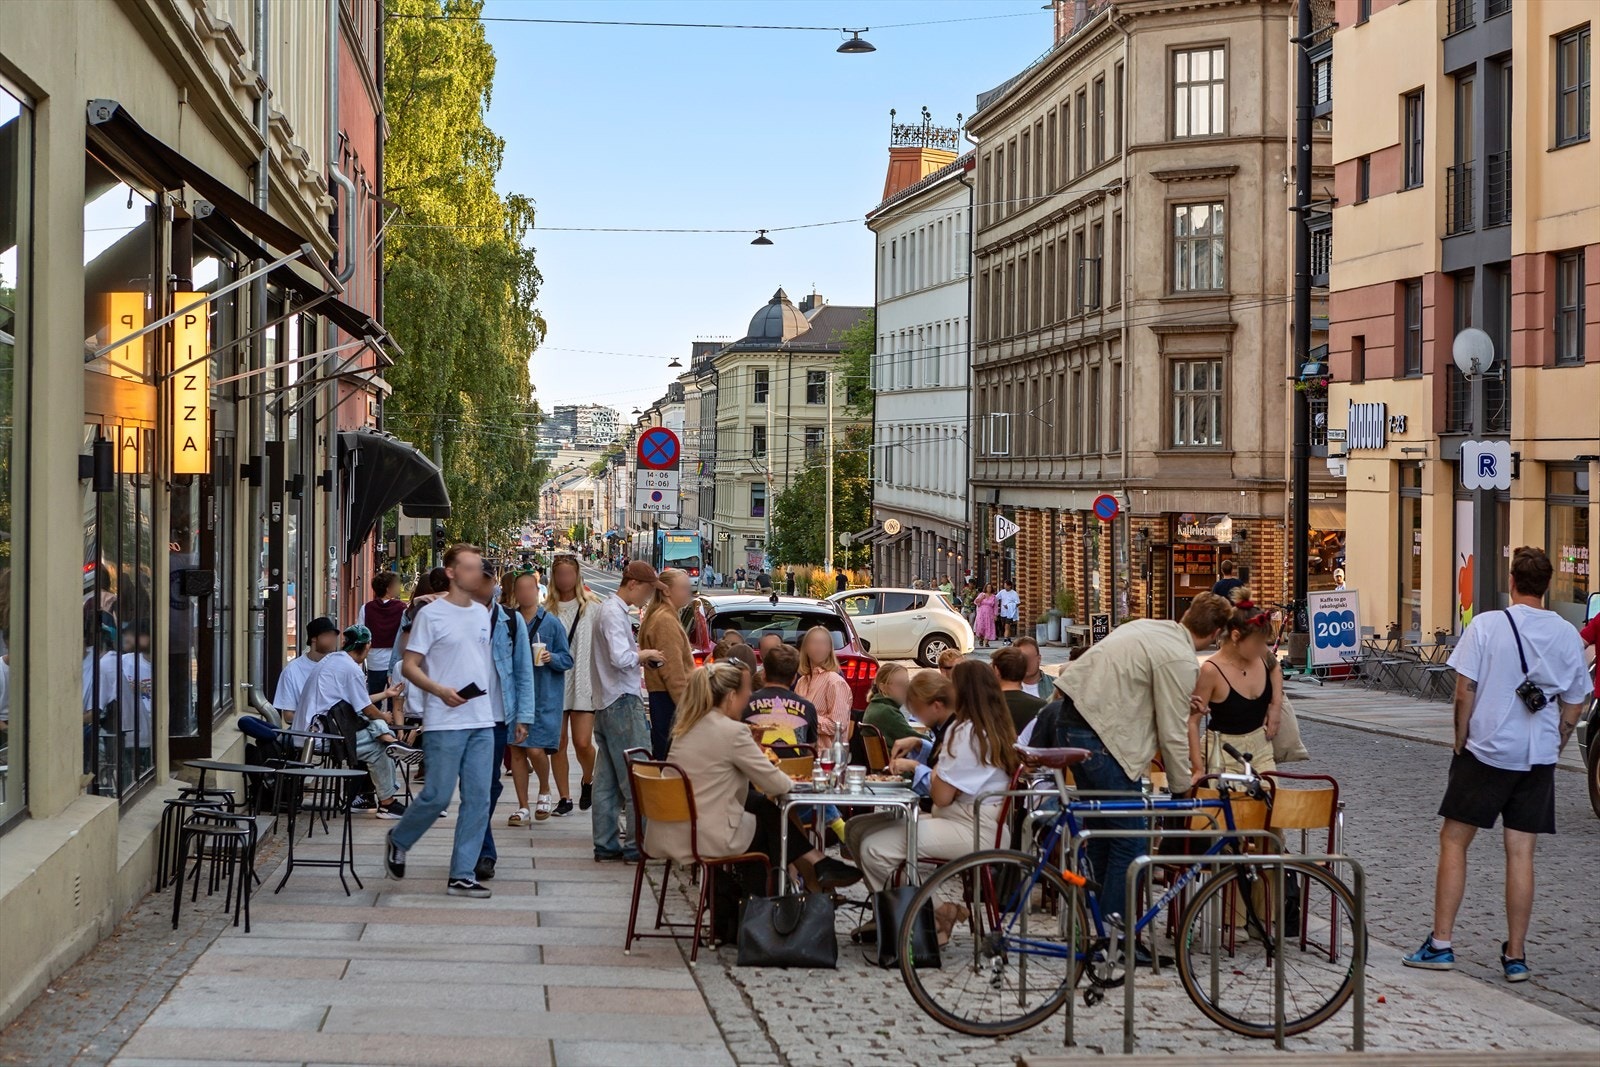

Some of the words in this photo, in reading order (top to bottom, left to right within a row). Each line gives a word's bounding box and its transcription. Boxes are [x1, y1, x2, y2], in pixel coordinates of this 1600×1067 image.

[183, 315, 197, 451] PIZZA
[1478, 453, 1497, 477] R
[998, 517, 1016, 540] BAR
